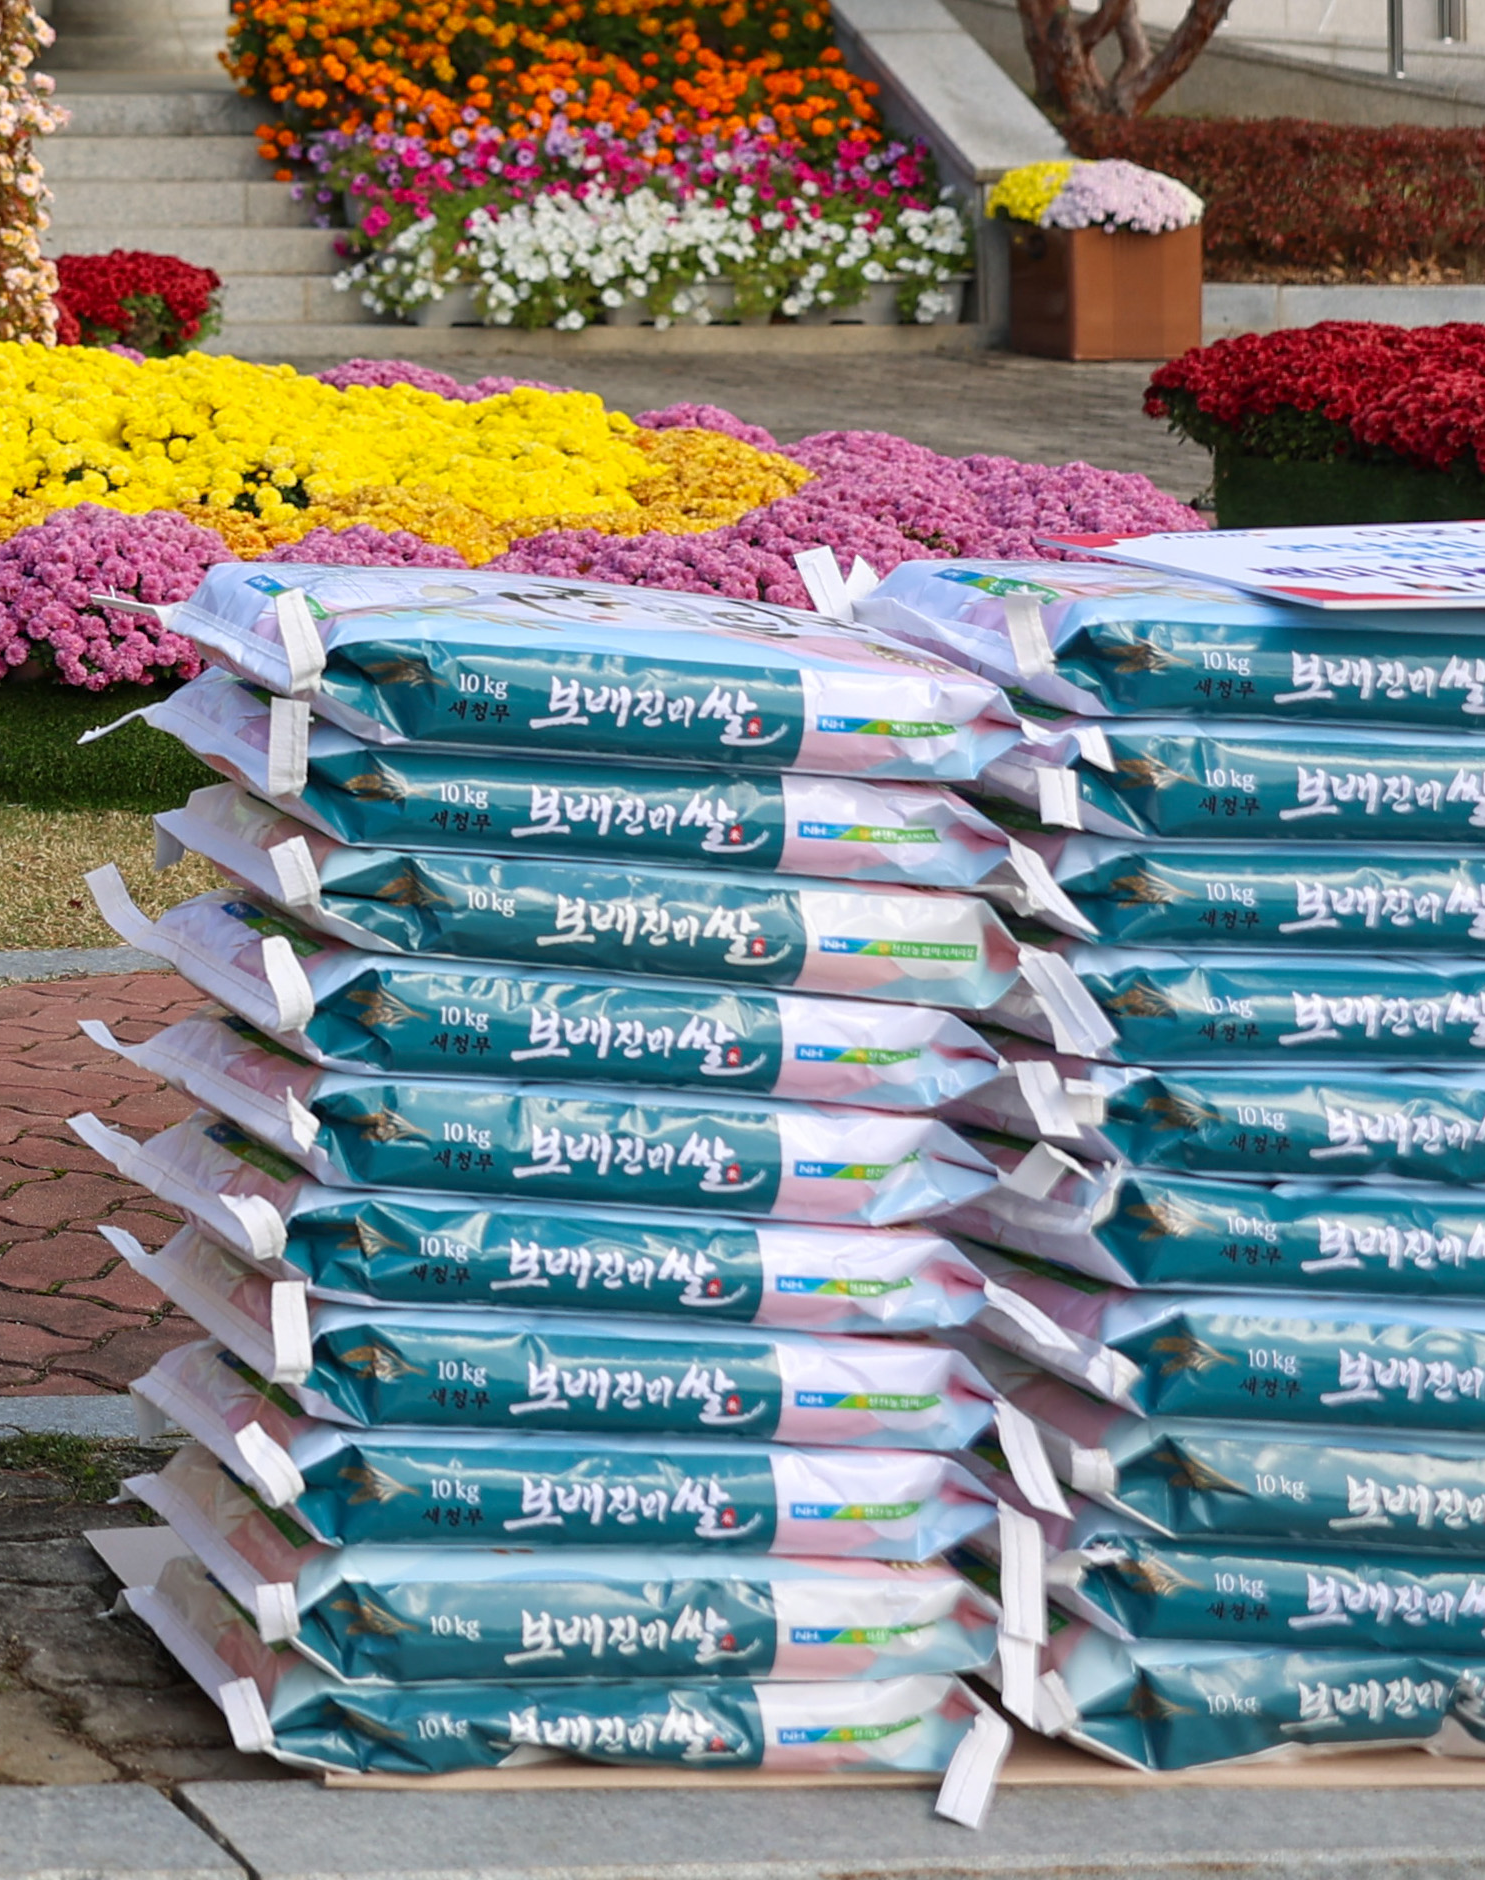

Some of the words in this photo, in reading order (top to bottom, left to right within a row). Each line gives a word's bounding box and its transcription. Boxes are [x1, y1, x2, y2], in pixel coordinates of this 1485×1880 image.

[529, 676, 788, 746] 보배진미쌀
[511, 785, 770, 853] 보배진미쌀
[536, 894, 792, 966] 보배진미쌀
[510, 1006, 767, 1077] 보배진미쌀
[512, 1124, 767, 1193] 보배진미쌀
[490, 1237, 748, 1306] 보배진미쌀
[509, 1360, 766, 1425] 보배진미쌀
[503, 1476, 762, 1539] 보배진미쌀
[504, 1604, 762, 1666] 보배진미쌀
